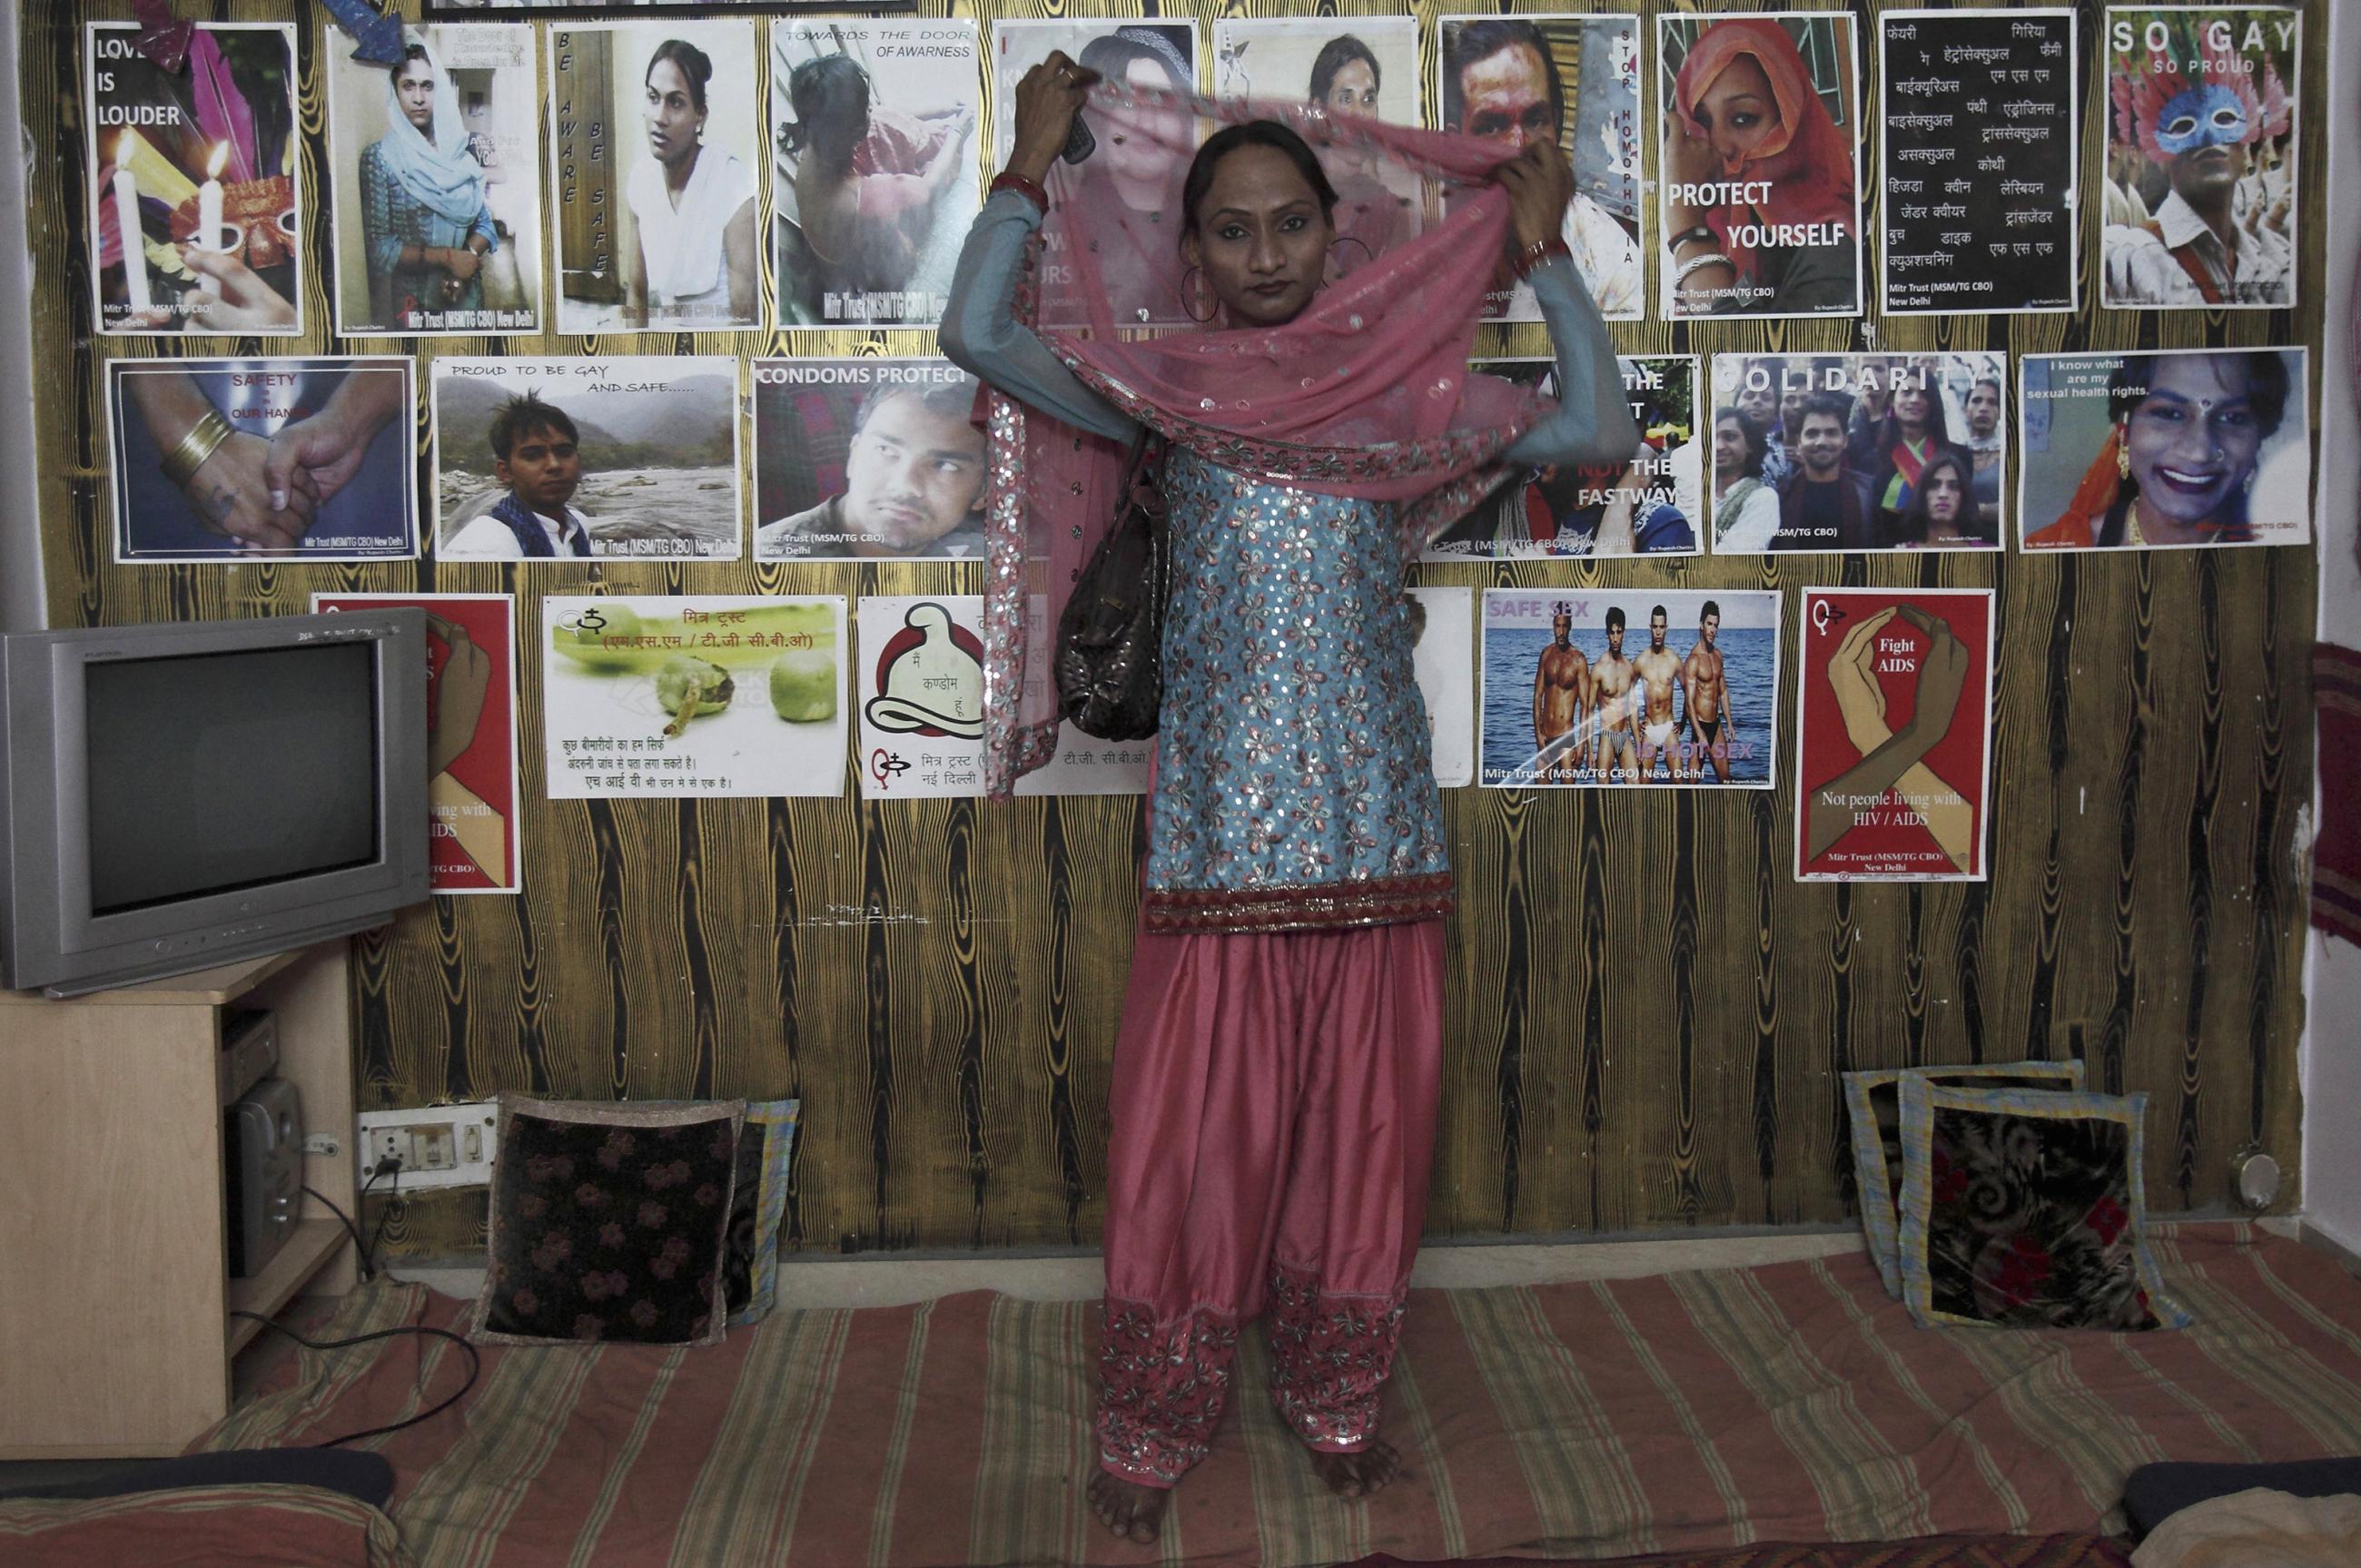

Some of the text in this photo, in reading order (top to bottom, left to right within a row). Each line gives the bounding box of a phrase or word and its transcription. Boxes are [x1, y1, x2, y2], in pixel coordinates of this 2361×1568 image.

[785, 30, 971, 41] TOWARDS THE DOOR
[2112, 21, 2295, 53] SO GAY
[97, 39, 145, 59] LOV
[876, 46, 971, 57] OF AWARNESS
[1622, 30, 1631, 89] STOP
[2154, 60, 2255, 74] SO PROUD
[98, 74, 114, 91] IS
[1991, 70, 2050, 84] एम एस एम
[98, 106, 180, 125] LOUDER
[1944, 178, 1971, 193] क्वीन
[1669, 182, 1773, 207] PROTECT
[1725, 223, 1844, 249] YOURSELF
[1990, 242, 2054, 258] एफ एस एफ
[1689, 287, 1774, 300] Trust (MSM/TG CBO)
[1889, 281, 1993, 294] Mitr Trust (MSM/TG CBO)
[1690, 303, 1712, 311] Delhi
[1889, 297, 1931, 306] New Delhi
[424, 311, 444, 328] Trust
[477, 310, 496, 330] CBO)
[497, 311, 514, 328] New
[516, 311, 534, 328] Delhi
[452, 365, 609, 379] PROUD TO BE GAY
[2051, 360, 2124, 370] I know what
[232, 374, 297, 387] SAFETY
[759, 367, 965, 384] CONDOMS PROTECT
[1623, 373, 1664, 390] THE
[1718, 367, 1979, 392] SOLIDARITY
[2067, 375, 2109, 385] are my
[587, 382, 621, 392] AND
[2027, 387, 2150, 399] sexual health rights.
[232, 409, 261, 419] OUR
[1630, 459, 1671, 476] THE
[1578, 487, 1677, 506] FASTWAY
[811, 534, 857, 543] (MSM/TG
[860, 534, 885, 543] CBO)
[785, 547, 811, 555] Delhi
[1489, 600, 1589, 617] SAFE SEX
[683, 608, 708, 624] मित्र
[690, 634, 696, 647] /
[1880, 638, 1915, 655] Fight
[1878, 658, 1915, 673] AIDS
[923, 674, 958, 690] कण्डोम
[562, 740, 578, 755] कुछ
[617, 739, 628, 751] का
[632, 739, 644, 751] हम
[1663, 741, 1707, 758] HOT
[1714, 742, 1753, 759] SEX
[617, 755, 624, 769] से
[627, 758, 640, 769] पता
[645, 758, 659, 769] लगा
[663, 755, 682, 769] सकते
[922, 754, 942, 767] मित्र
[585, 775, 601, 789] एच
[606, 772, 625, 789] आई
[629, 773, 641, 788] वी
[660, 779, 674, 788] उन
[689, 776, 696, 788] से
[701, 779, 716, 789] एक
[922, 772, 976, 785] नई दिल्ली
[1485, 768, 1704, 780] Mitr Trust (MSM/TG CBO) New Delhi
[1823, 791, 1961, 810] Not people living with
[461, 802, 491, 816] with
[1853, 812, 1929, 826] HIV / AIDS
[1851, 853, 1872, 861] Trust
[1874, 853, 1917, 862] (MSM/TG
[1919, 853, 1943, 862] CBO)
[1864, 863, 1907, 872] New Delhi
